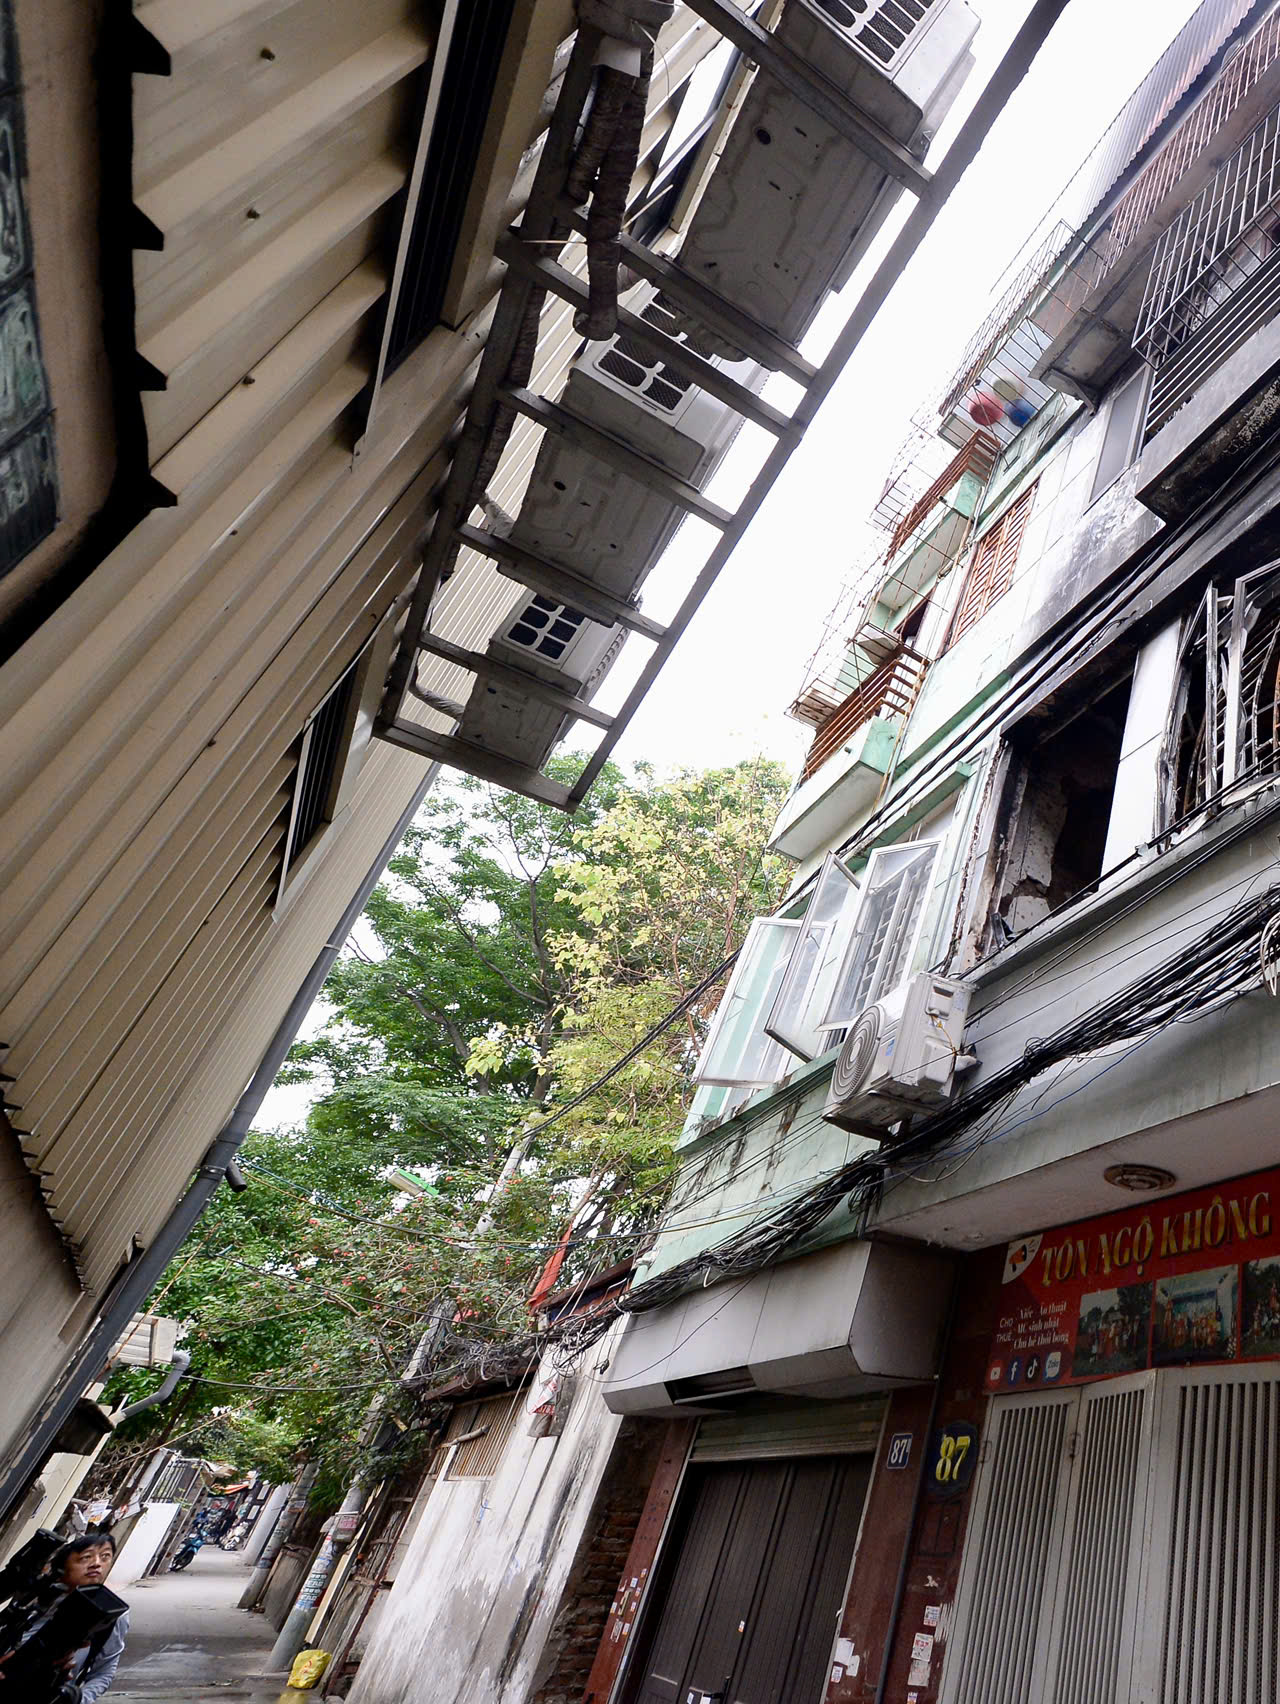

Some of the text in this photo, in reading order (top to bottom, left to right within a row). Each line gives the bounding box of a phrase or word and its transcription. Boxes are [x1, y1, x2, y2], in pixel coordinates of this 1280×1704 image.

[1039, 1235, 1091, 1287] TÔN
[1095, 1215, 1155, 1276] NGỘ
[1159, 1191, 1270, 1259] KHÔNG
[890, 1439, 908, 1464] 87
[935, 1434, 971, 1482] 87
